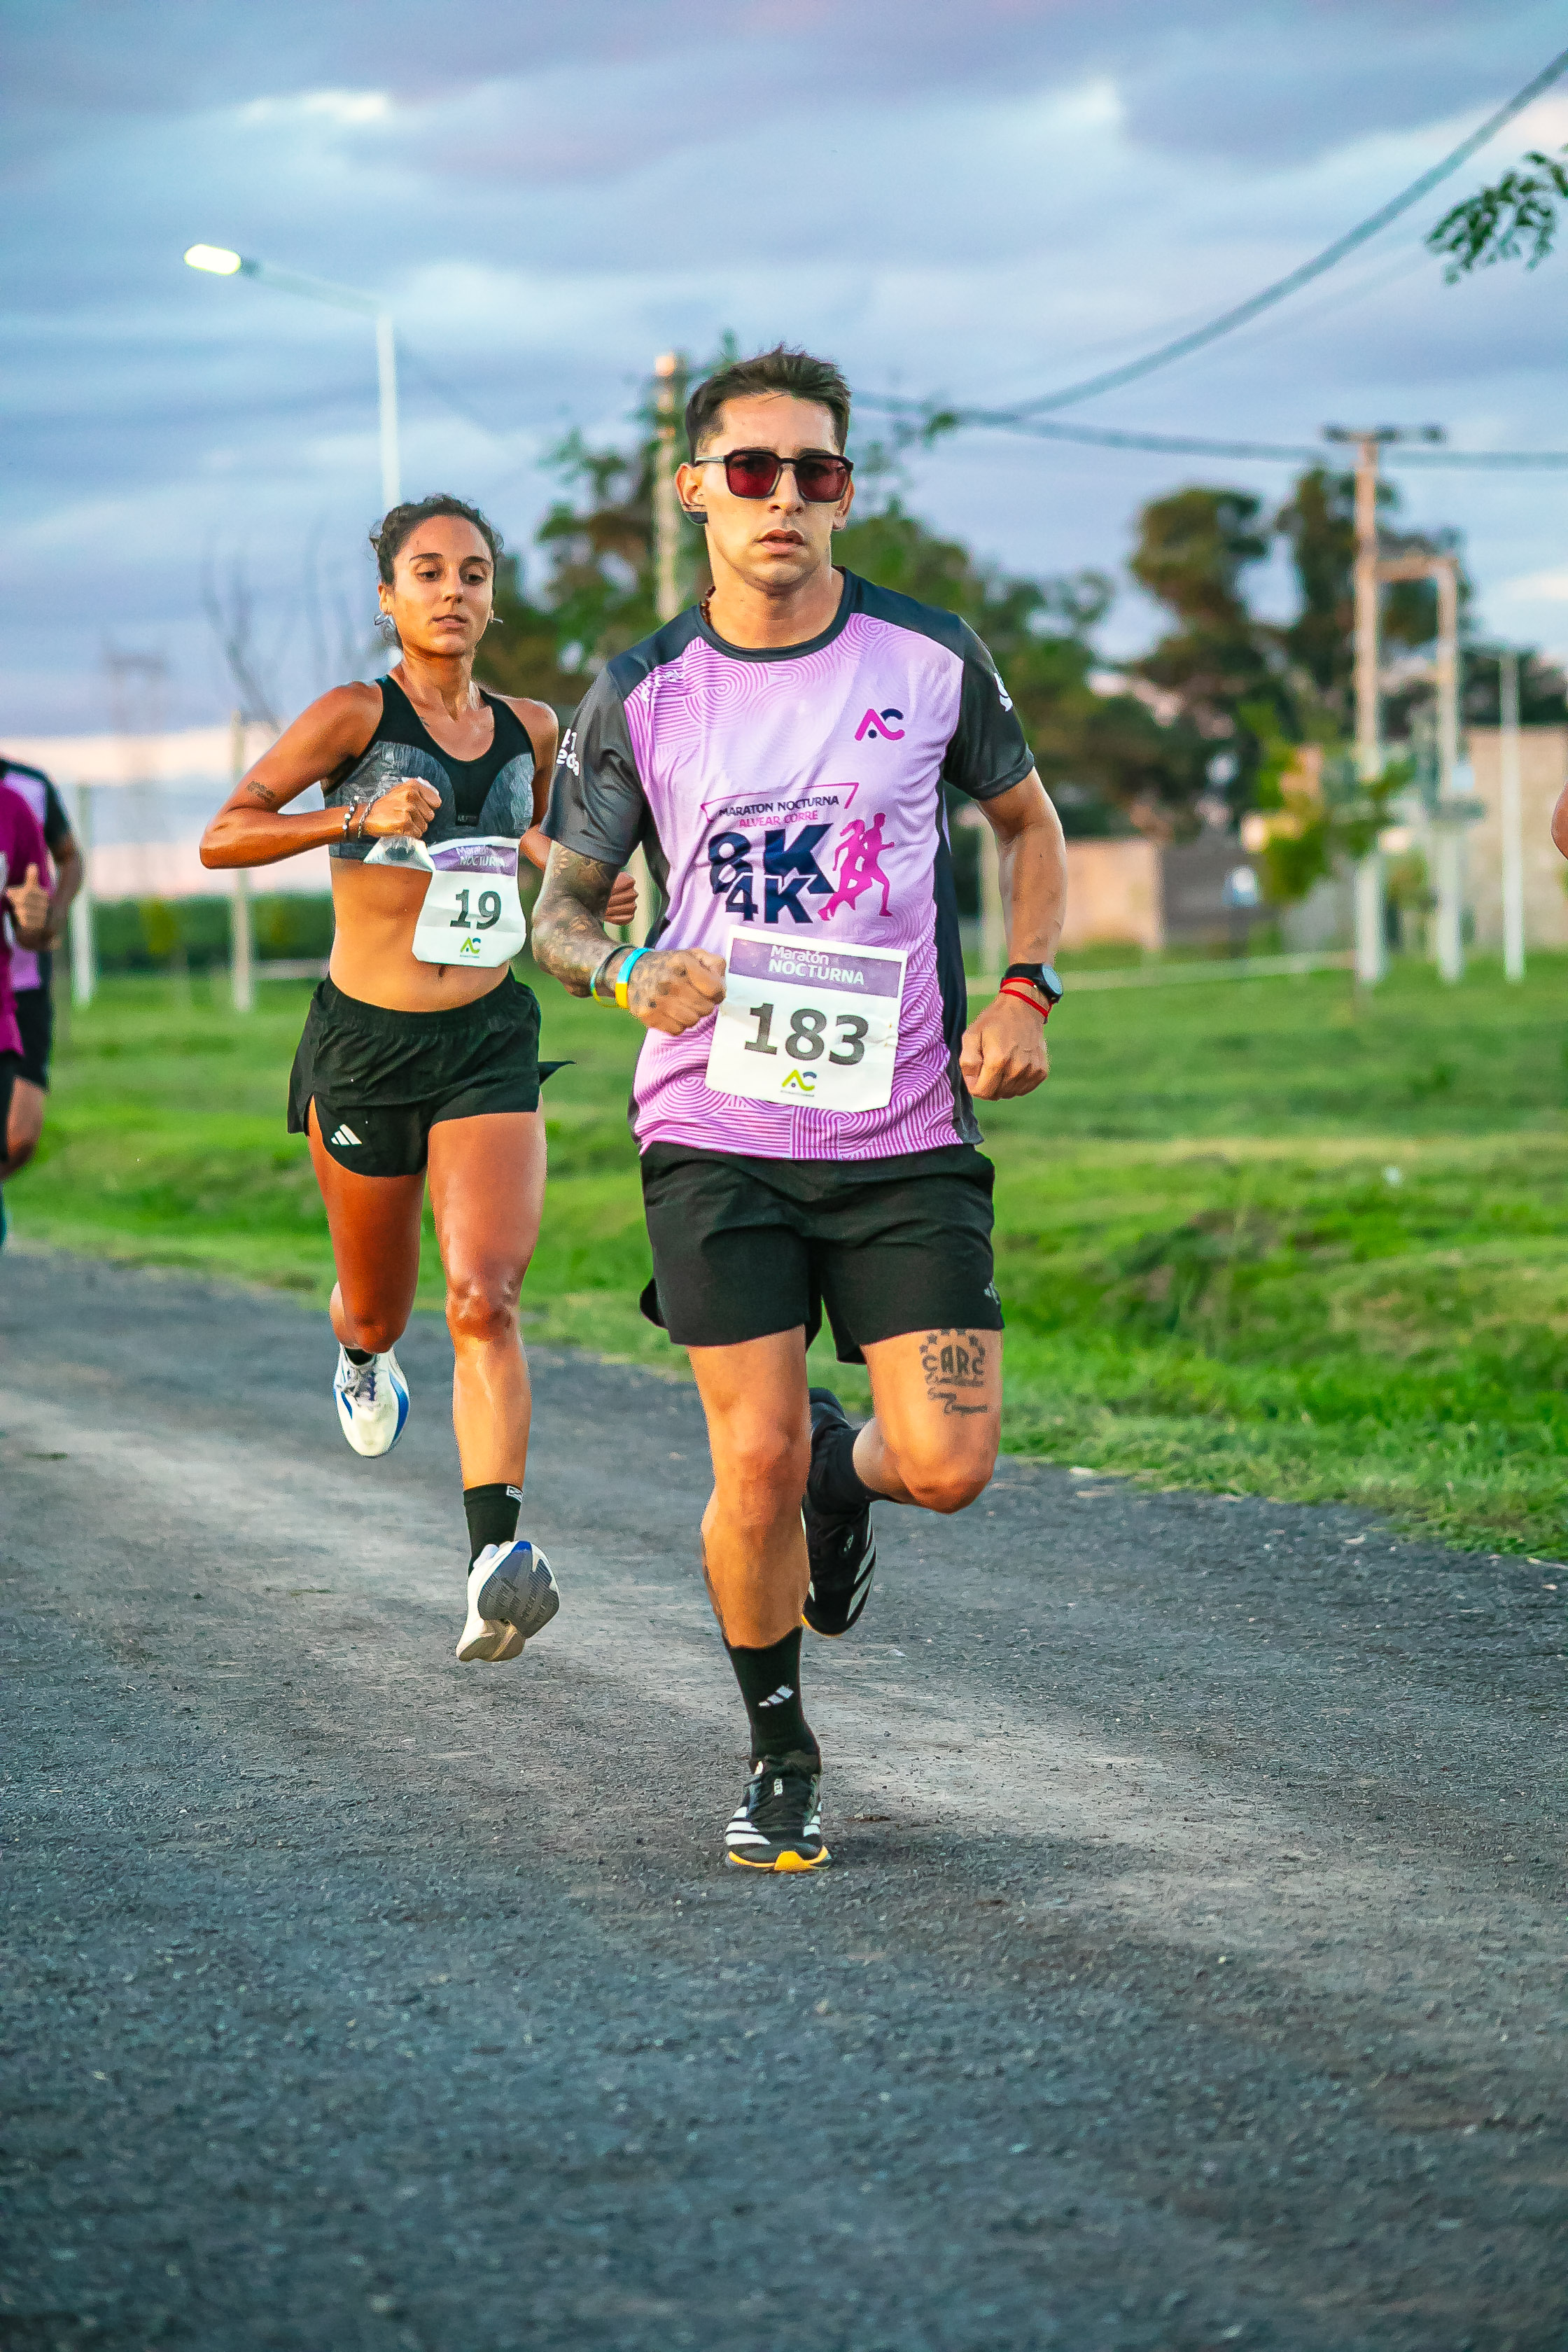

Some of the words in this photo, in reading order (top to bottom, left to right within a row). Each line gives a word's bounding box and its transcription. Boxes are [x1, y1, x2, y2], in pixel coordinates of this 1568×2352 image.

[778, 795, 839, 811] NOCTURNA
[739, 816, 780, 828] ALVEAR
[784, 810, 818, 824] CORRE
[449, 889, 502, 930] 19
[725, 876, 813, 924] 4K
[770, 945, 830, 965] Maratón
[769, 958, 864, 986] NOCTURNA
[744, 1002, 868, 1065] 183
